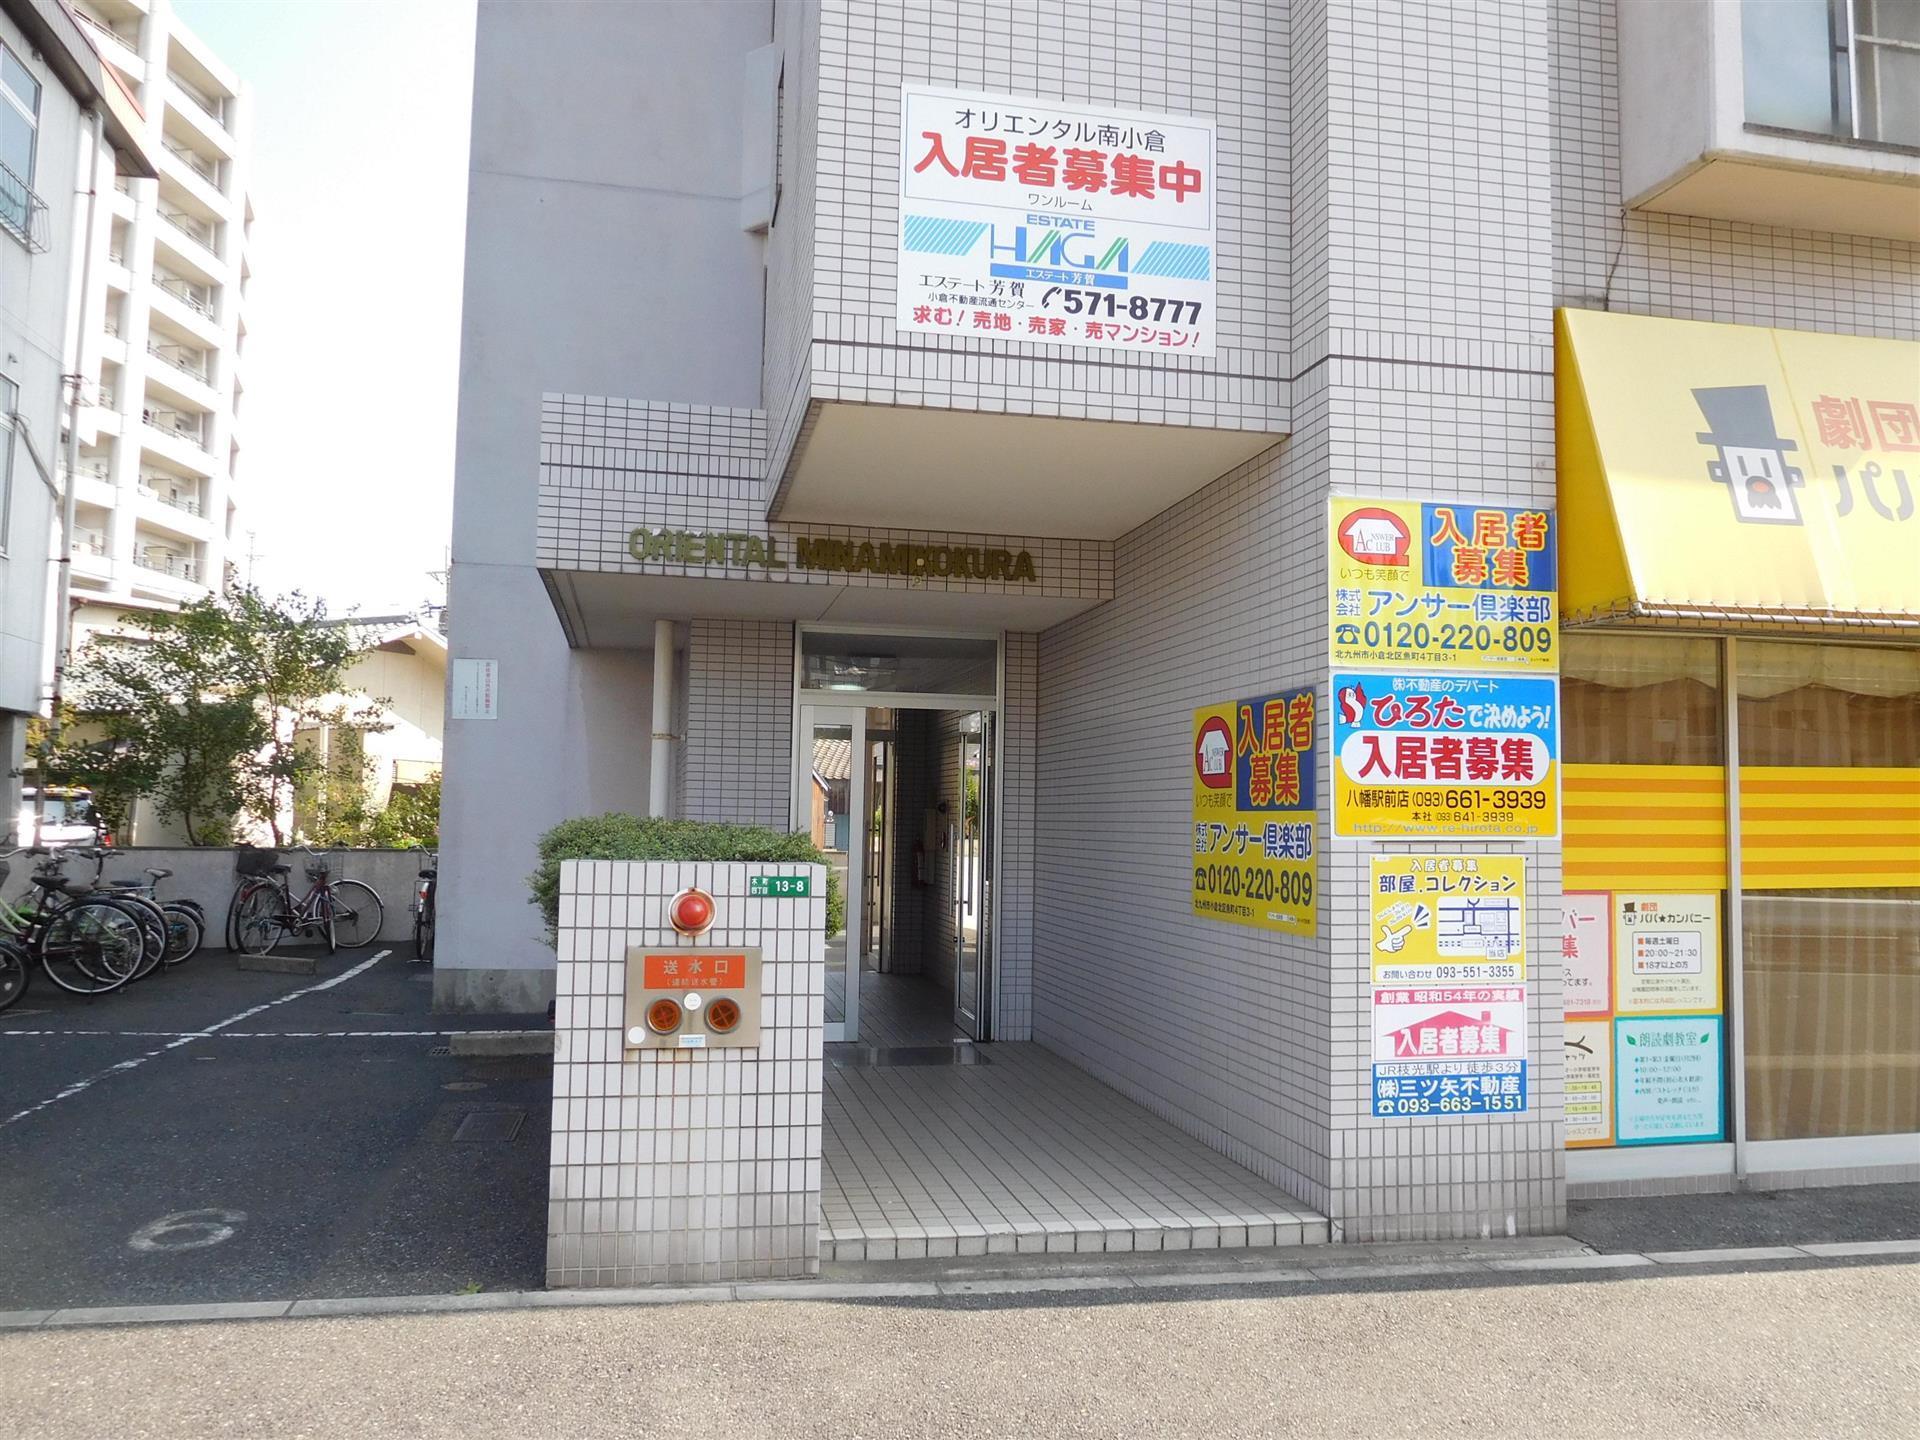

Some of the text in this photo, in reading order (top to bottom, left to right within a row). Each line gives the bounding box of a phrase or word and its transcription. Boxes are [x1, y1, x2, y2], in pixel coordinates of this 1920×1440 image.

[955, 108, 1166, 153] オリエンタル南小倉
[913, 131, 1202, 203] 入居者募集中
[1027, 193, 1093, 211] ワンルーム
[1026, 214, 1096, 231] ESTATE
[1063, 289, 1202, 325] 571-8777
[1811, 394, 1920, 452] 劇団
[1432, 509, 1547, 549] 入居者
[629, 527, 1036, 582] ORIENTAL MINAMIKOKURA
[1454, 548, 1528, 586] 募集
[1340, 567, 1410, 582] いつも笑顔で
[1367, 591, 1551, 623] アンサー倶楽部
[1364, 621, 1551, 652] 0120-220-809
[1239, 694, 1313, 754] 入居者
[1358, 735, 1534, 781] 入居者募集
[1250, 752, 1299, 806] 募集
[1346, 789, 1409, 808] 八幡駅前店
[1412, 811, 1431, 821] 本社
[1209, 823, 1312, 860] アンサー倶楽部
[1410, 859, 1479, 873] 入居者募集
[776, 880, 804, 892] 13-8
[1208, 863, 1313, 907] 0120-220-809
[664, 959, 728, 975] 送水口
[1383, 965, 1515, 980] お問い合わせ 093-551-3355
[1397, 1025, 1501, 1056] 入居者募集
[1640, 1032, 1697, 1047] 朗読劇教室
[1398, 1096, 1522, 1113] 093-663-1551
